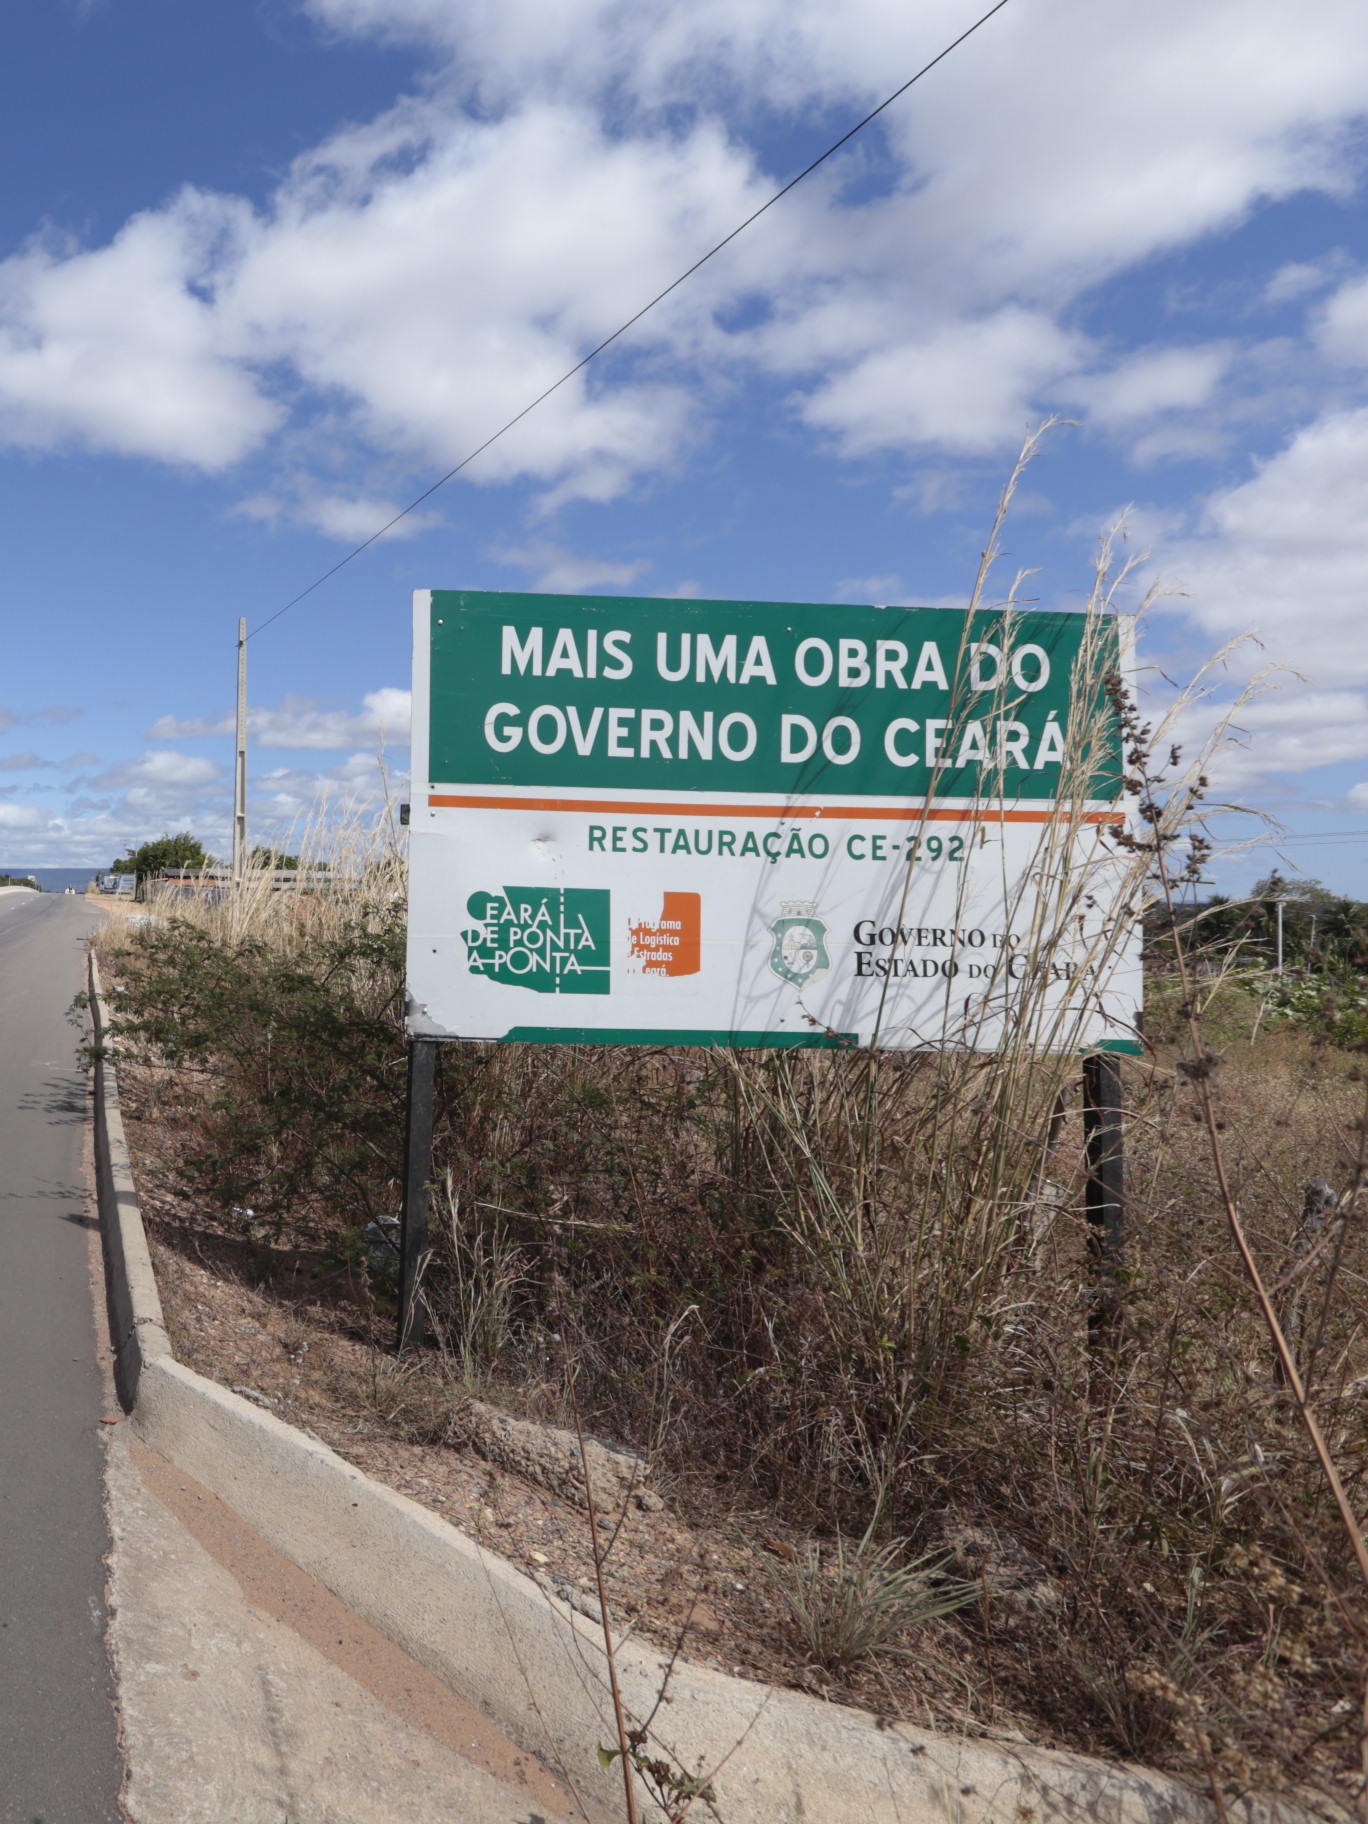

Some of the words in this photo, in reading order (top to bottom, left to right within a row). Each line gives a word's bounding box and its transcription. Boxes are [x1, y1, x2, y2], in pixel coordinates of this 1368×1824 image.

[501, 625, 633, 680] MAIS
[656, 632, 777, 685] UMA
[794, 637, 949, 691] OBRA
[969, 643, 1051, 693] DO
[484, 702, 758, 762] GOVERNO
[780, 714, 862, 765] DO
[884, 710, 1072, 770] CEARÁ
[588, 824, 830, 864] RESTAURAÇÃO
[846, 834, 965, 863] CE-292
[509, 914, 596, 950] PONTA
[853, 920, 986, 948] GOVERNO
[494, 946, 583, 975] PONTA
[854, 951, 959, 978] ESTADO
